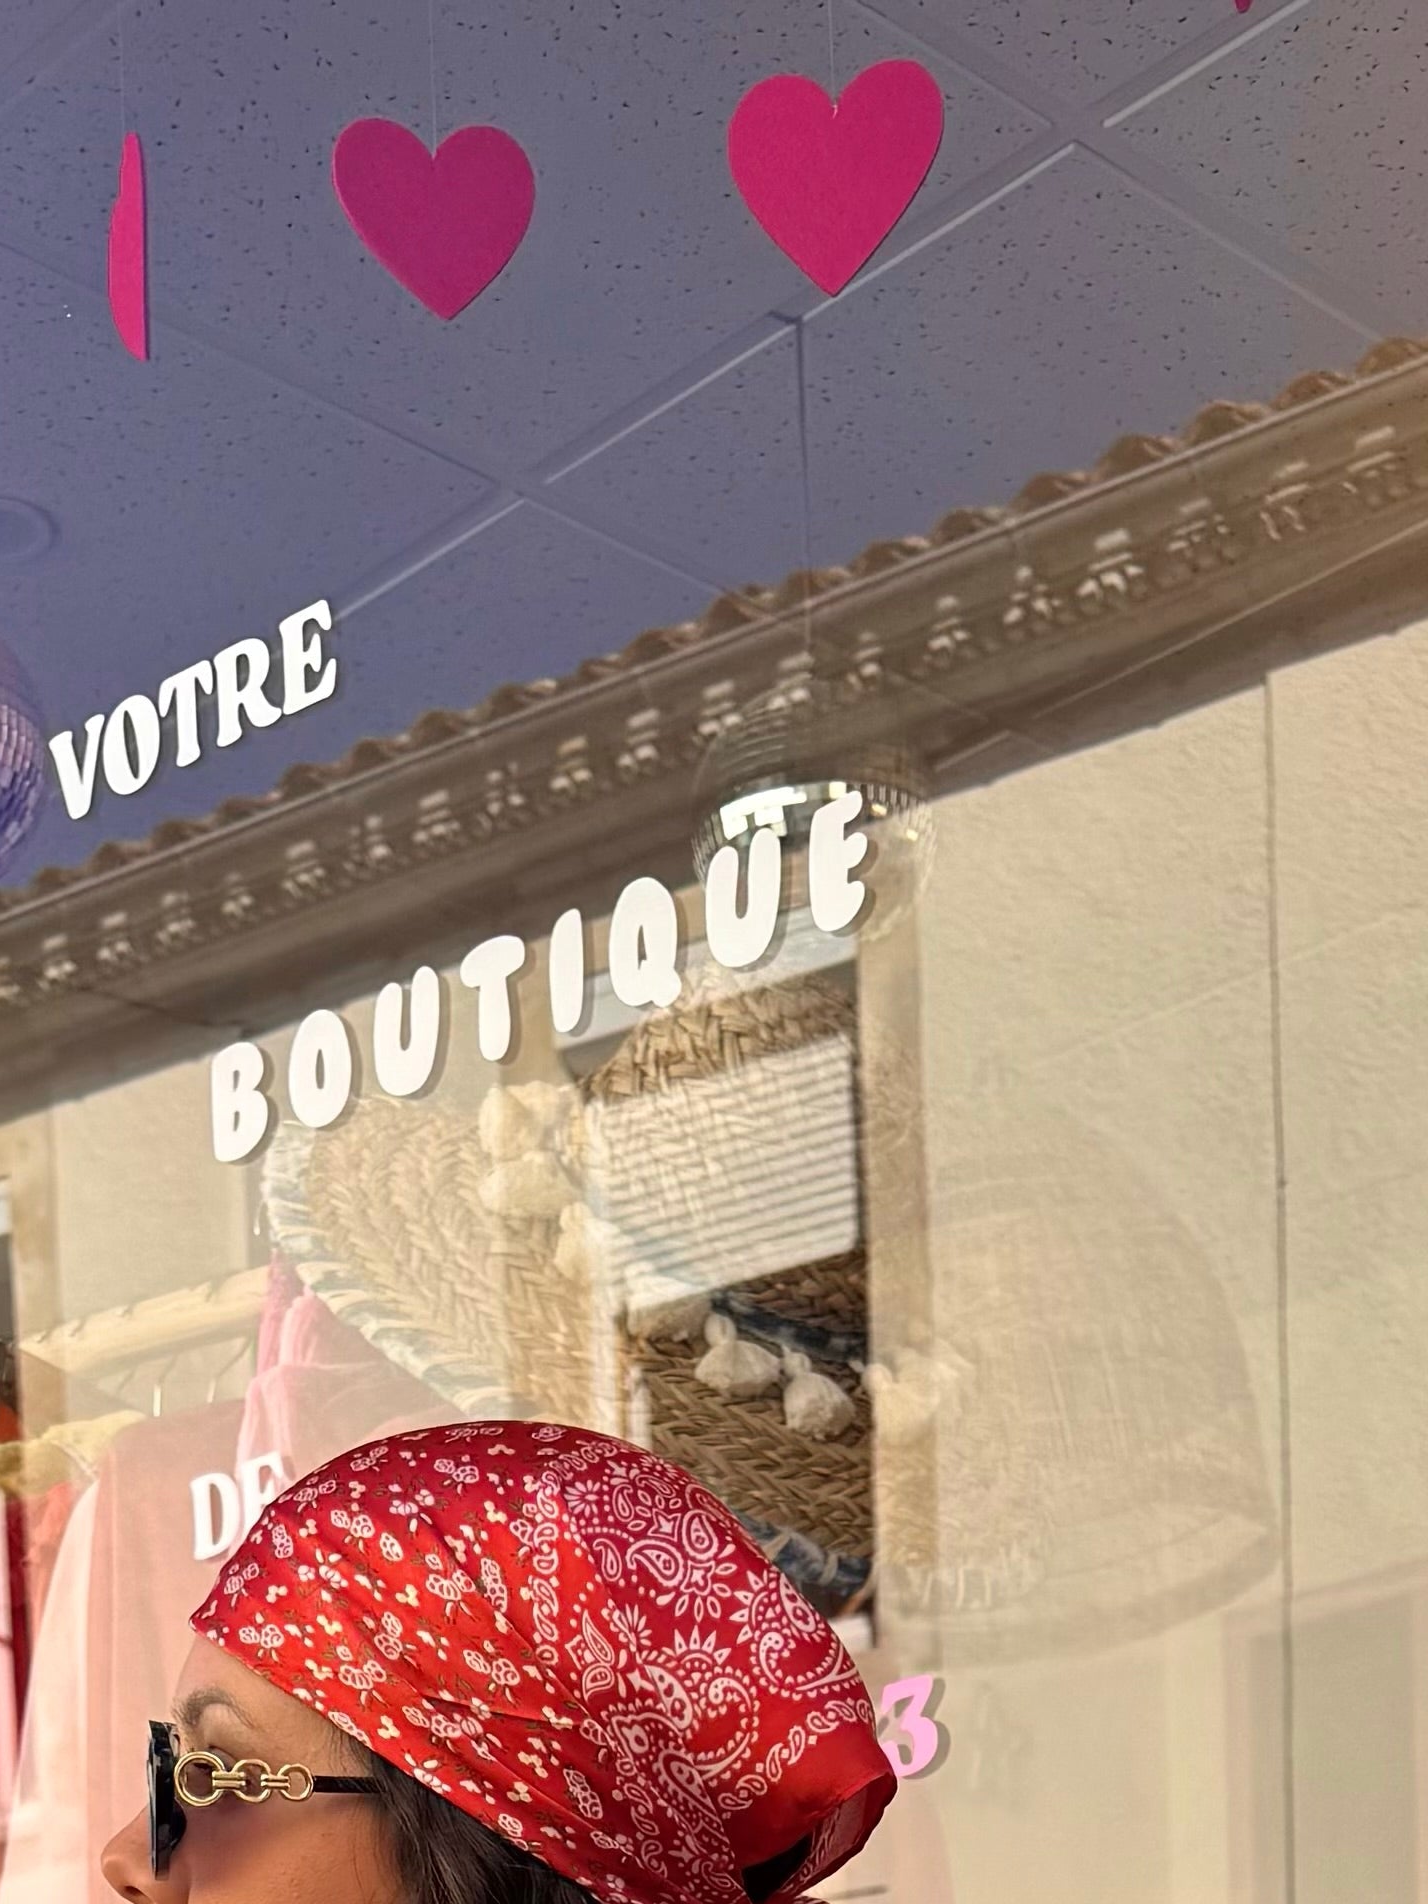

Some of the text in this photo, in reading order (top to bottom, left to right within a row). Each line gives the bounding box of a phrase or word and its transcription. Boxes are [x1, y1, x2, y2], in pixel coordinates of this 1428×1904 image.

[47, 599, 339, 820] VOTRE
[210, 790, 868, 1163] BOUTIQUE
[189, 1450, 287, 1562] DE
